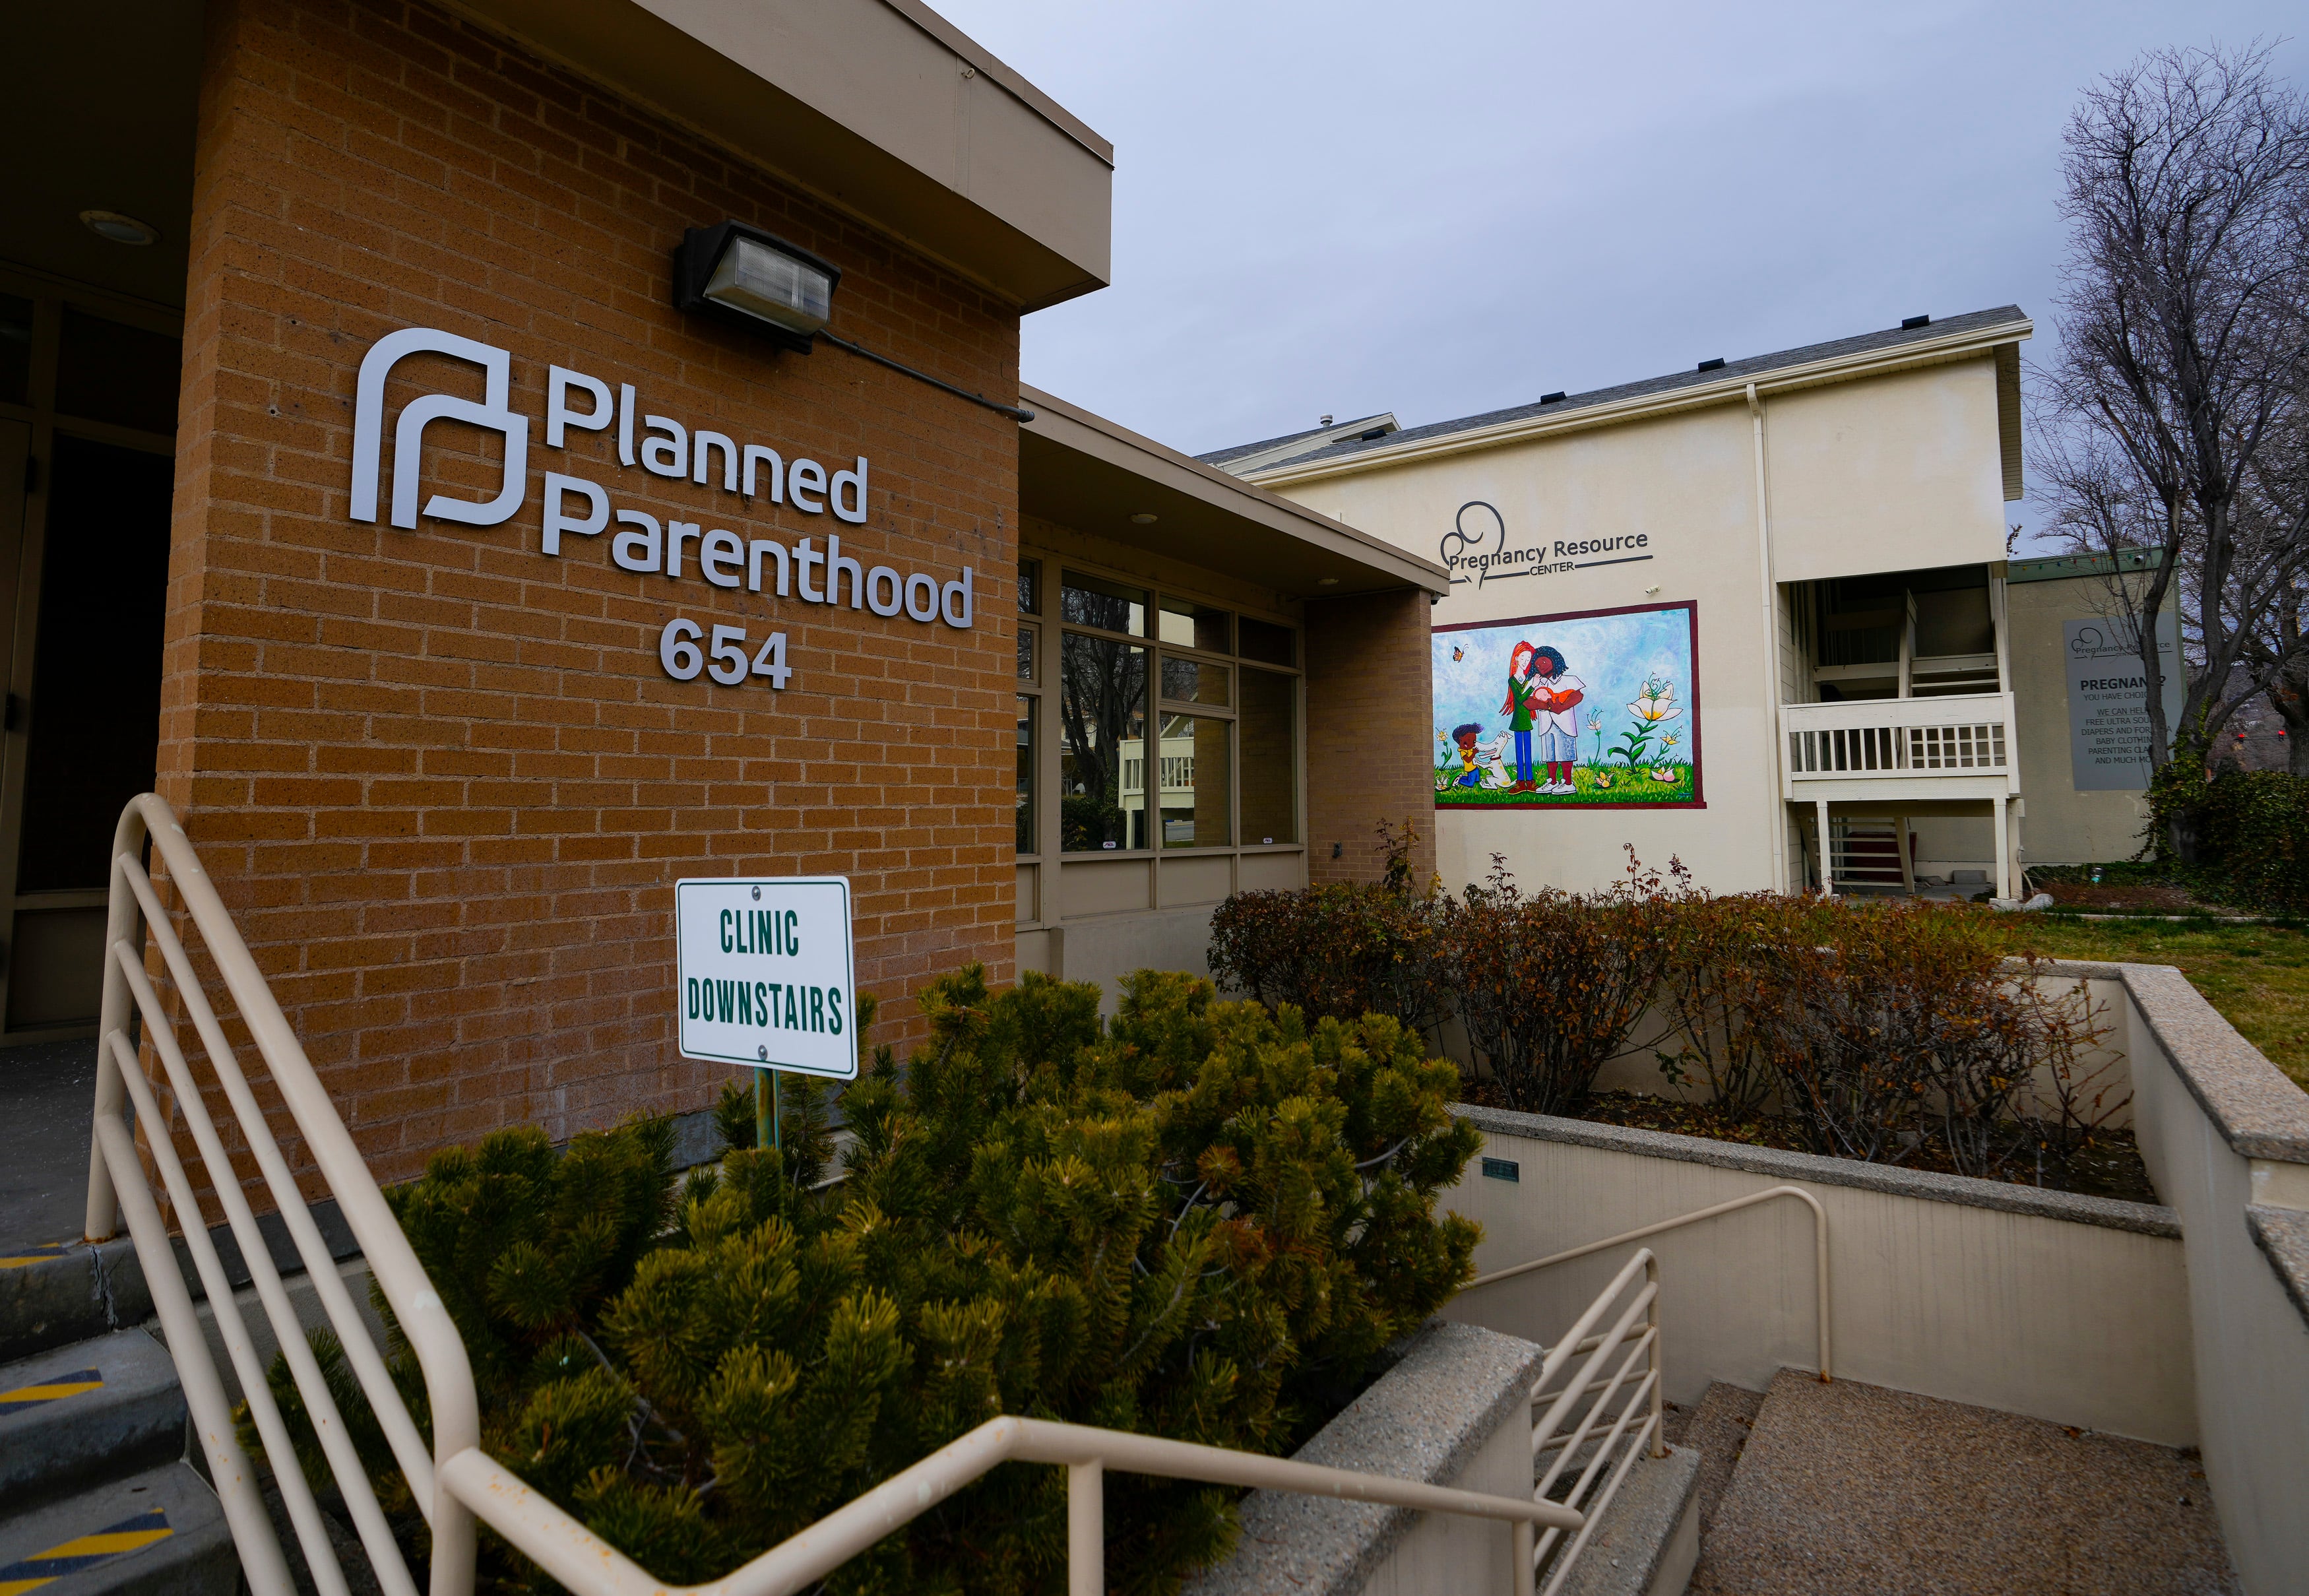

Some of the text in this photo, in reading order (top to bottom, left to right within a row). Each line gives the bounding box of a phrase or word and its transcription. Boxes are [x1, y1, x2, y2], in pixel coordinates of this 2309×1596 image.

[546, 364, 868, 524] Planned
[542, 470, 973, 629] Parenthood
[1449, 534, 1648, 571] Pregnancy Resource
[1530, 562, 1575, 576] CENTER
[660, 618, 792, 690] 654
[2081, 675, 2167, 691] PREGNAN?
[720, 909, 799, 957] CLINIC
[687, 977, 843, 1036] DOWNSTAIRS
